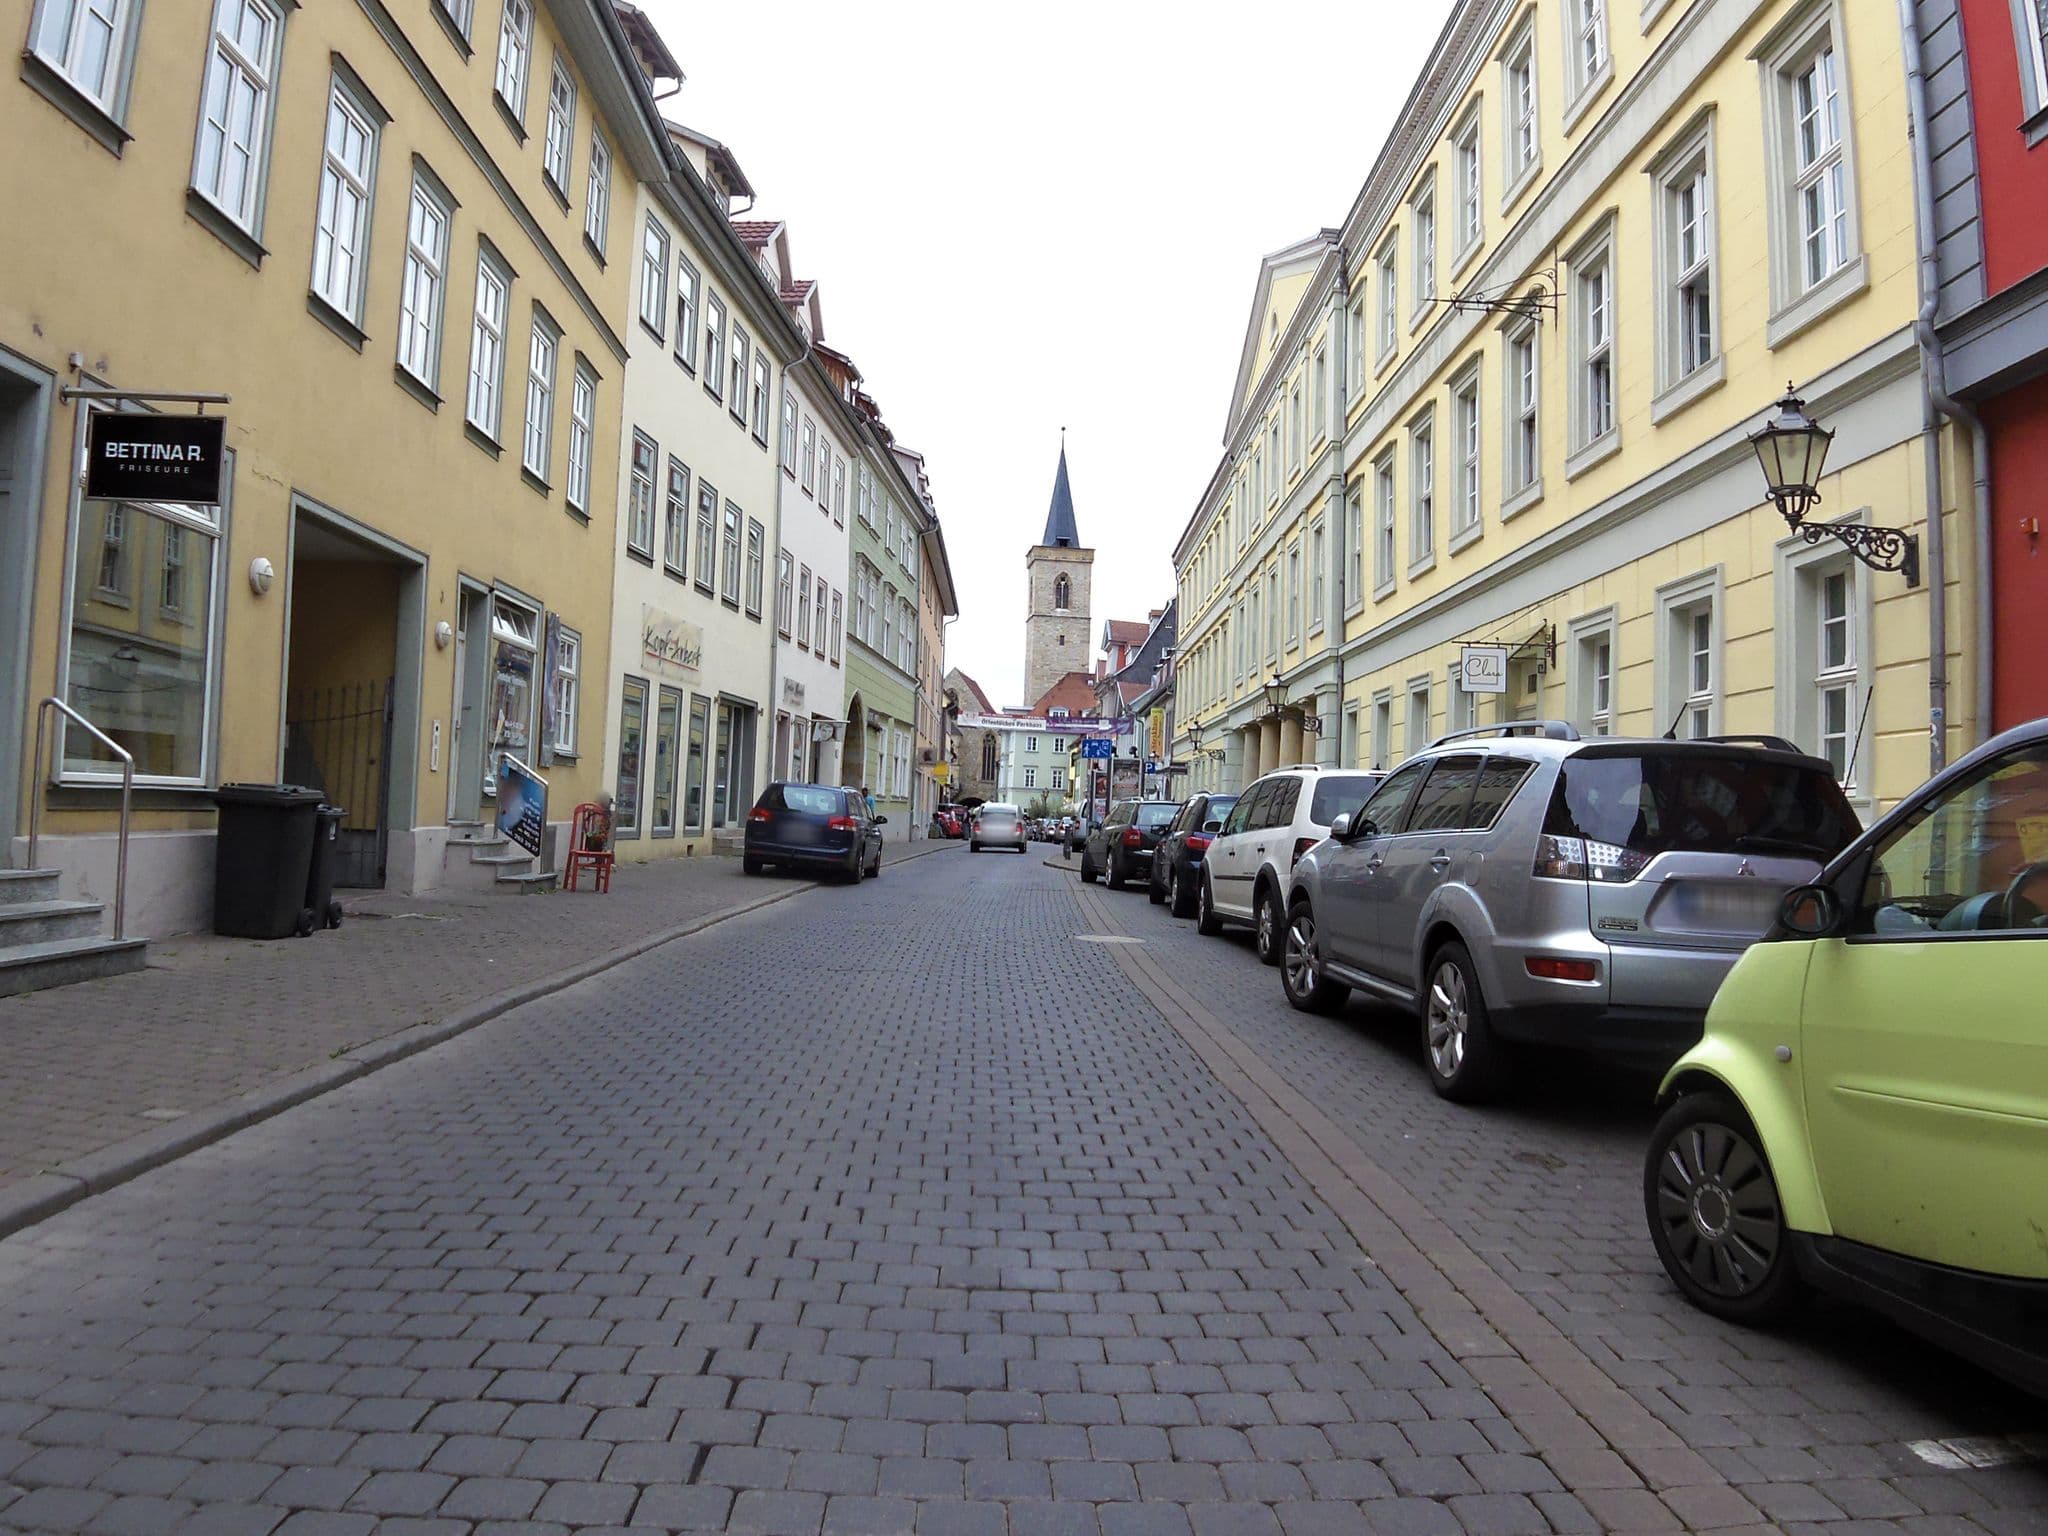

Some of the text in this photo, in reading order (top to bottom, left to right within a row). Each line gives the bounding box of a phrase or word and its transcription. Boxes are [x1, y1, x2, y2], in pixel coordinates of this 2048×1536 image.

[105, 441, 205, 462] BETTINA R.
[119, 464, 190, 474] FRISEURE
